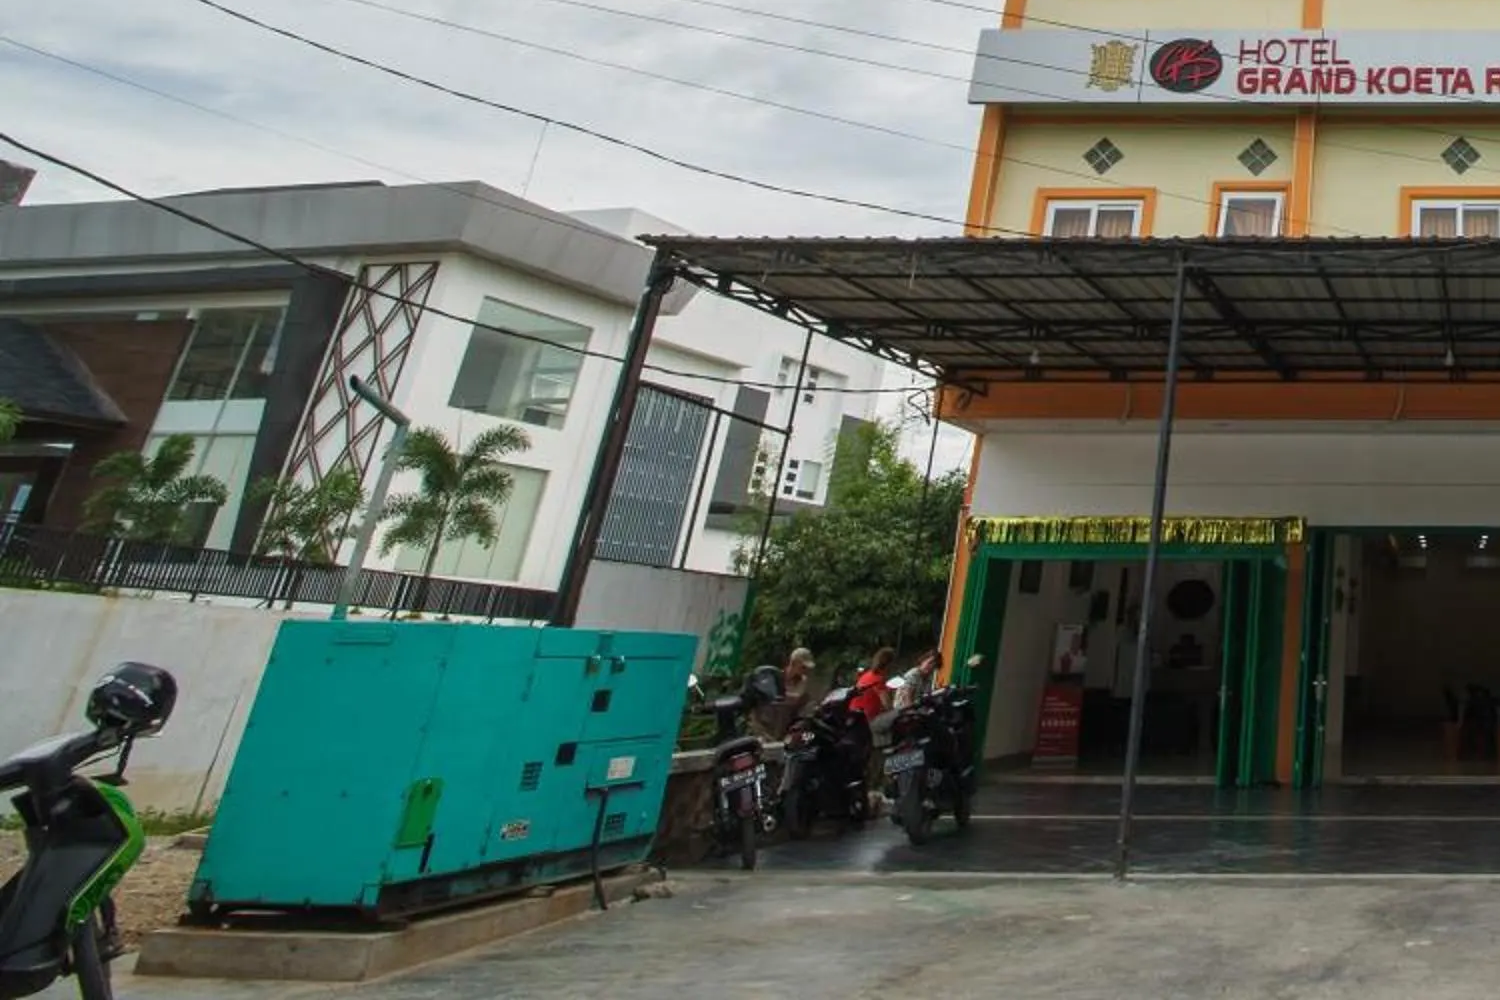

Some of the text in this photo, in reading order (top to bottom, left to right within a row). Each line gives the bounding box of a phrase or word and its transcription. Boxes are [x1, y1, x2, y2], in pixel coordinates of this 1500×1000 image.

[1238, 39, 1351, 65] HOTEL
[1236, 67, 1357, 95] GRAND
[1366, 66, 1475, 95] KOETA
